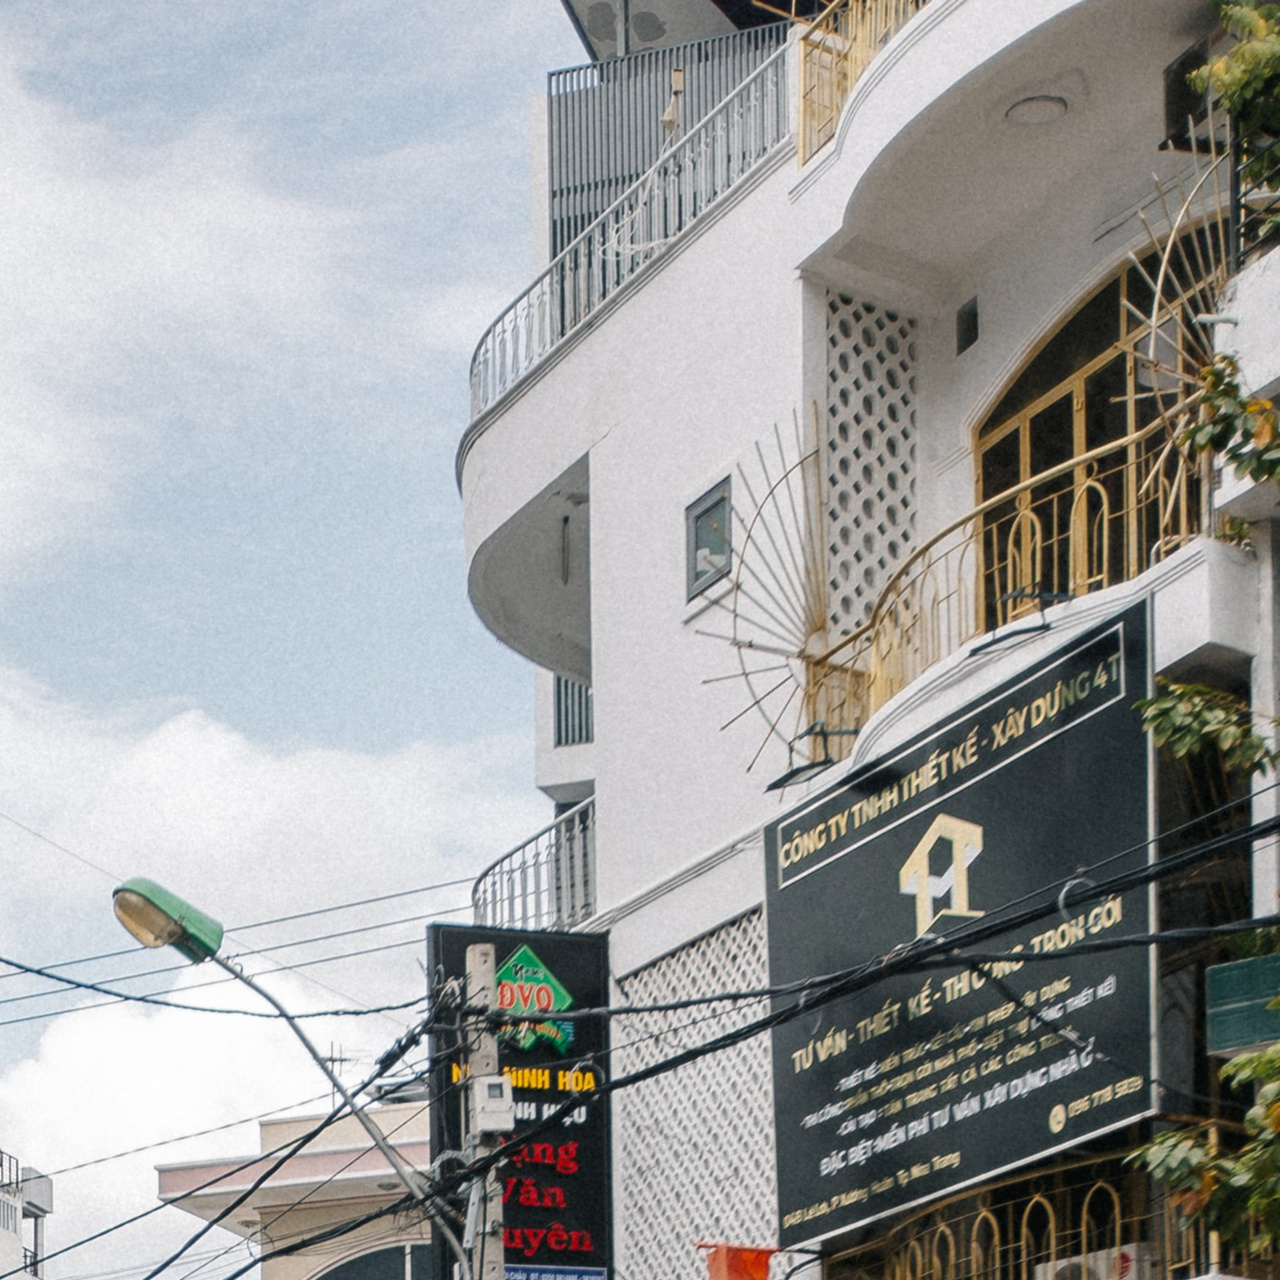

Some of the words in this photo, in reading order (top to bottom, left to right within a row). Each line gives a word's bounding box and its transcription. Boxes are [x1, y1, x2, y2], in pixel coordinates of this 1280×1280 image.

[780, 823, 827, 869] CÔNG
[826, 810, 851, 842] TY
[850, 785, 900, 830] TNHH
[899, 748, 949, 800] THIẾT
[950, 726, 981, 776] KẾ
[992, 707, 1033, 751] XÂY
[1031, 670, 1093, 727] DỰNG
[1092, 651, 1122, 691] 4T
[791, 1038, 815, 1075] TƯ
[815, 1025, 847, 1064] VẤN
[856, 998, 901, 1045] THIẾT
[907, 978, 934, 1021] KẾ
